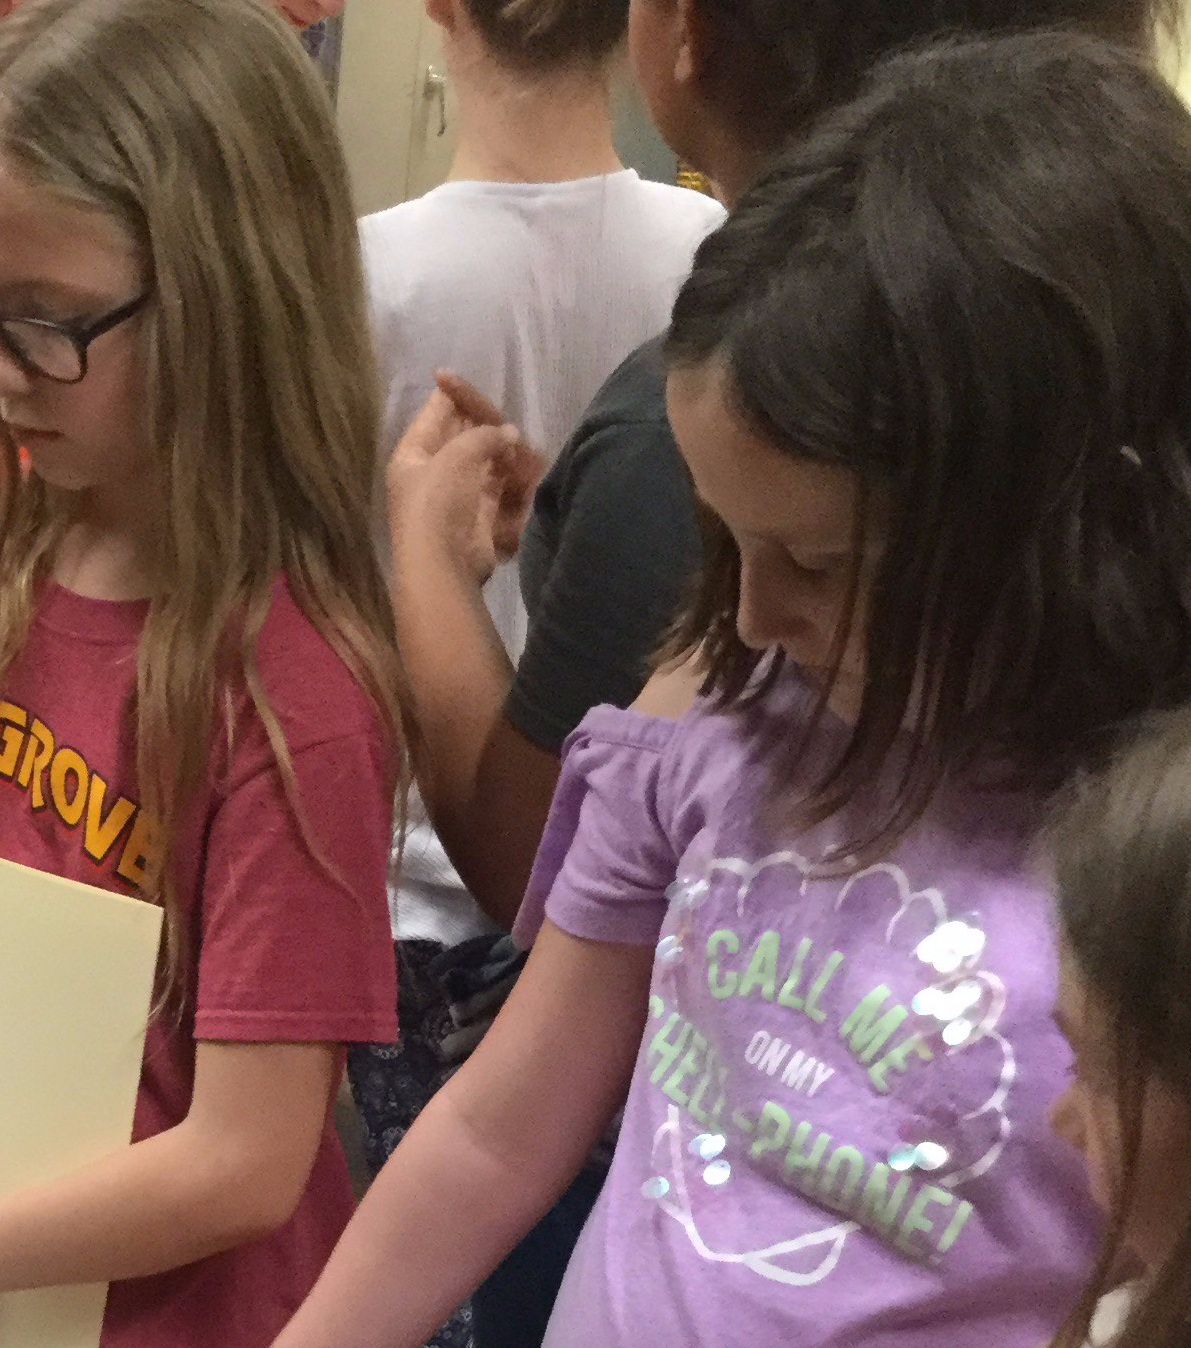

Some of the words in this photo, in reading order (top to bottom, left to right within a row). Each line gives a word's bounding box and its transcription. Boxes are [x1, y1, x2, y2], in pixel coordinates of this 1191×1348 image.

[705, 928, 845, 1024] CALL
[838, 984, 934, 1094] ME
[744, 1030, 792, 1077] ON
[780, 1049, 836, 1098] MY
